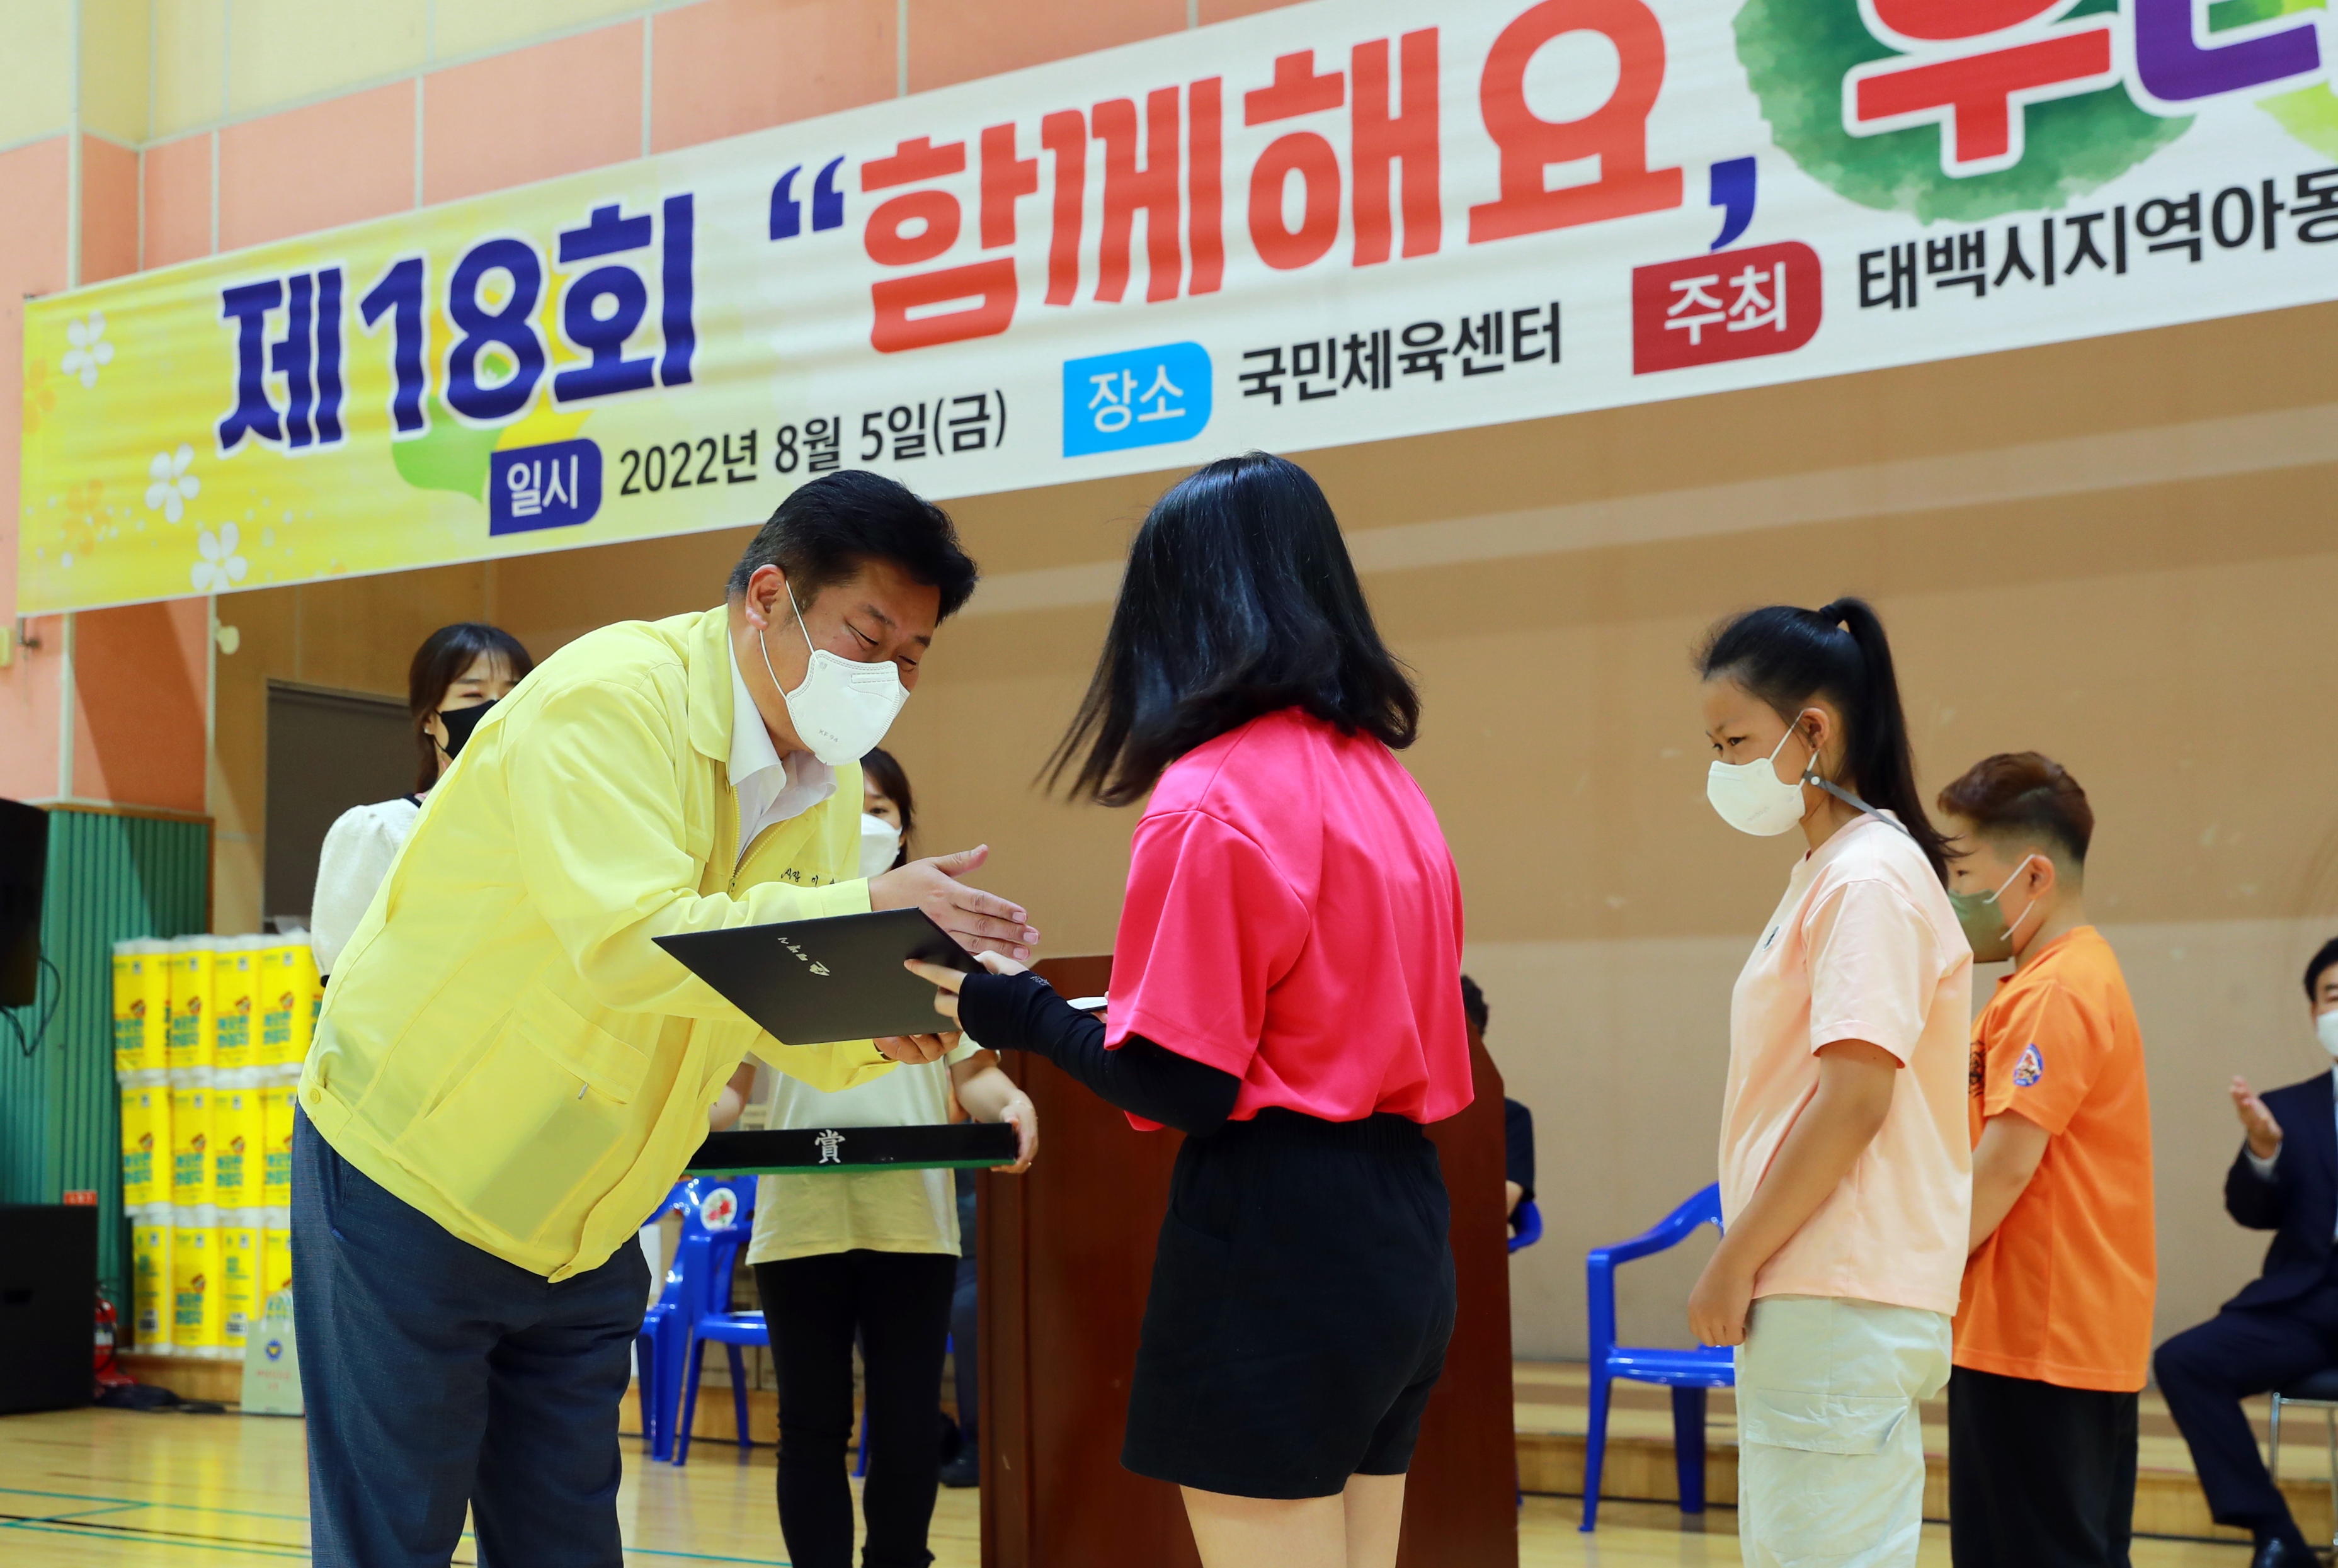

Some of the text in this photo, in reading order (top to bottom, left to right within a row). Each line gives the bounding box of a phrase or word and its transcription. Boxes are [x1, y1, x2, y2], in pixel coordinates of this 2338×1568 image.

[219, 193, 695, 450] 제18회
[506, 453, 579, 518] 일시
[620, 429, 758, 496] 2022년
[775, 416, 841, 475] 8월
[860, 389, 1006, 462] 5일(금)
[1087, 365, 1185, 433] 장소
[1238, 302, 1561, 406] 국민체육센터
[1665, 262, 1788, 346] 주최
[830, 734, 838, 743] 94
[781, 868, 801, 883] 시장
[814, 1129, 845, 1164] 賞
